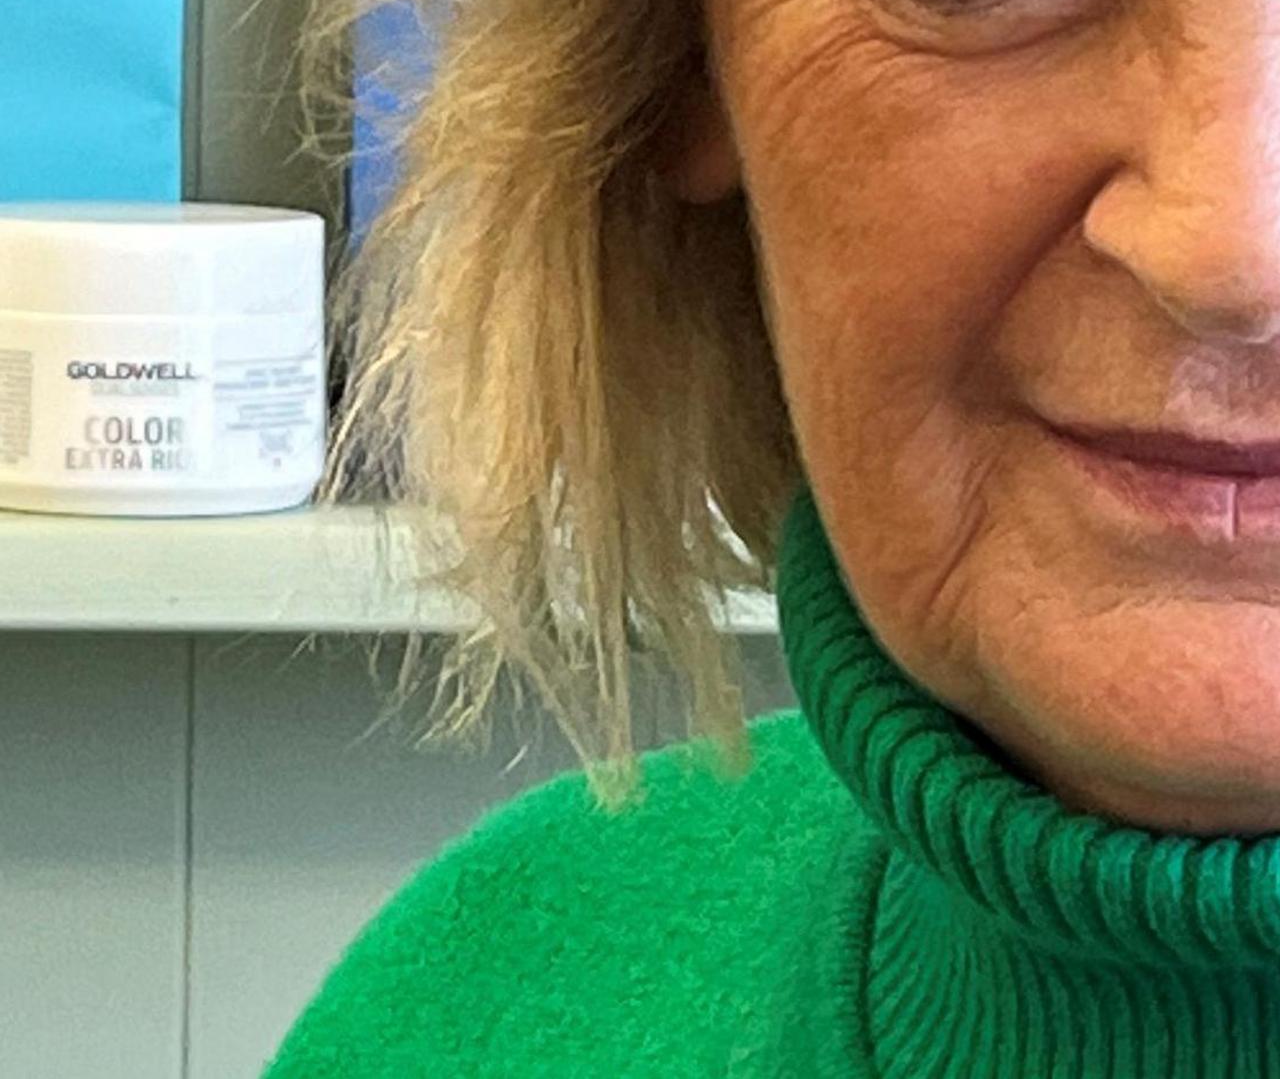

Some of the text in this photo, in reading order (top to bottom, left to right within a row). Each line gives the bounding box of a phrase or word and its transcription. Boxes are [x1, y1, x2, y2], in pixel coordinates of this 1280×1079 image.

[66, 360, 200, 381] GOLDWELL
[84, 416, 185, 445] COLOR
[65, 447, 197, 472] EXTRA RIC
